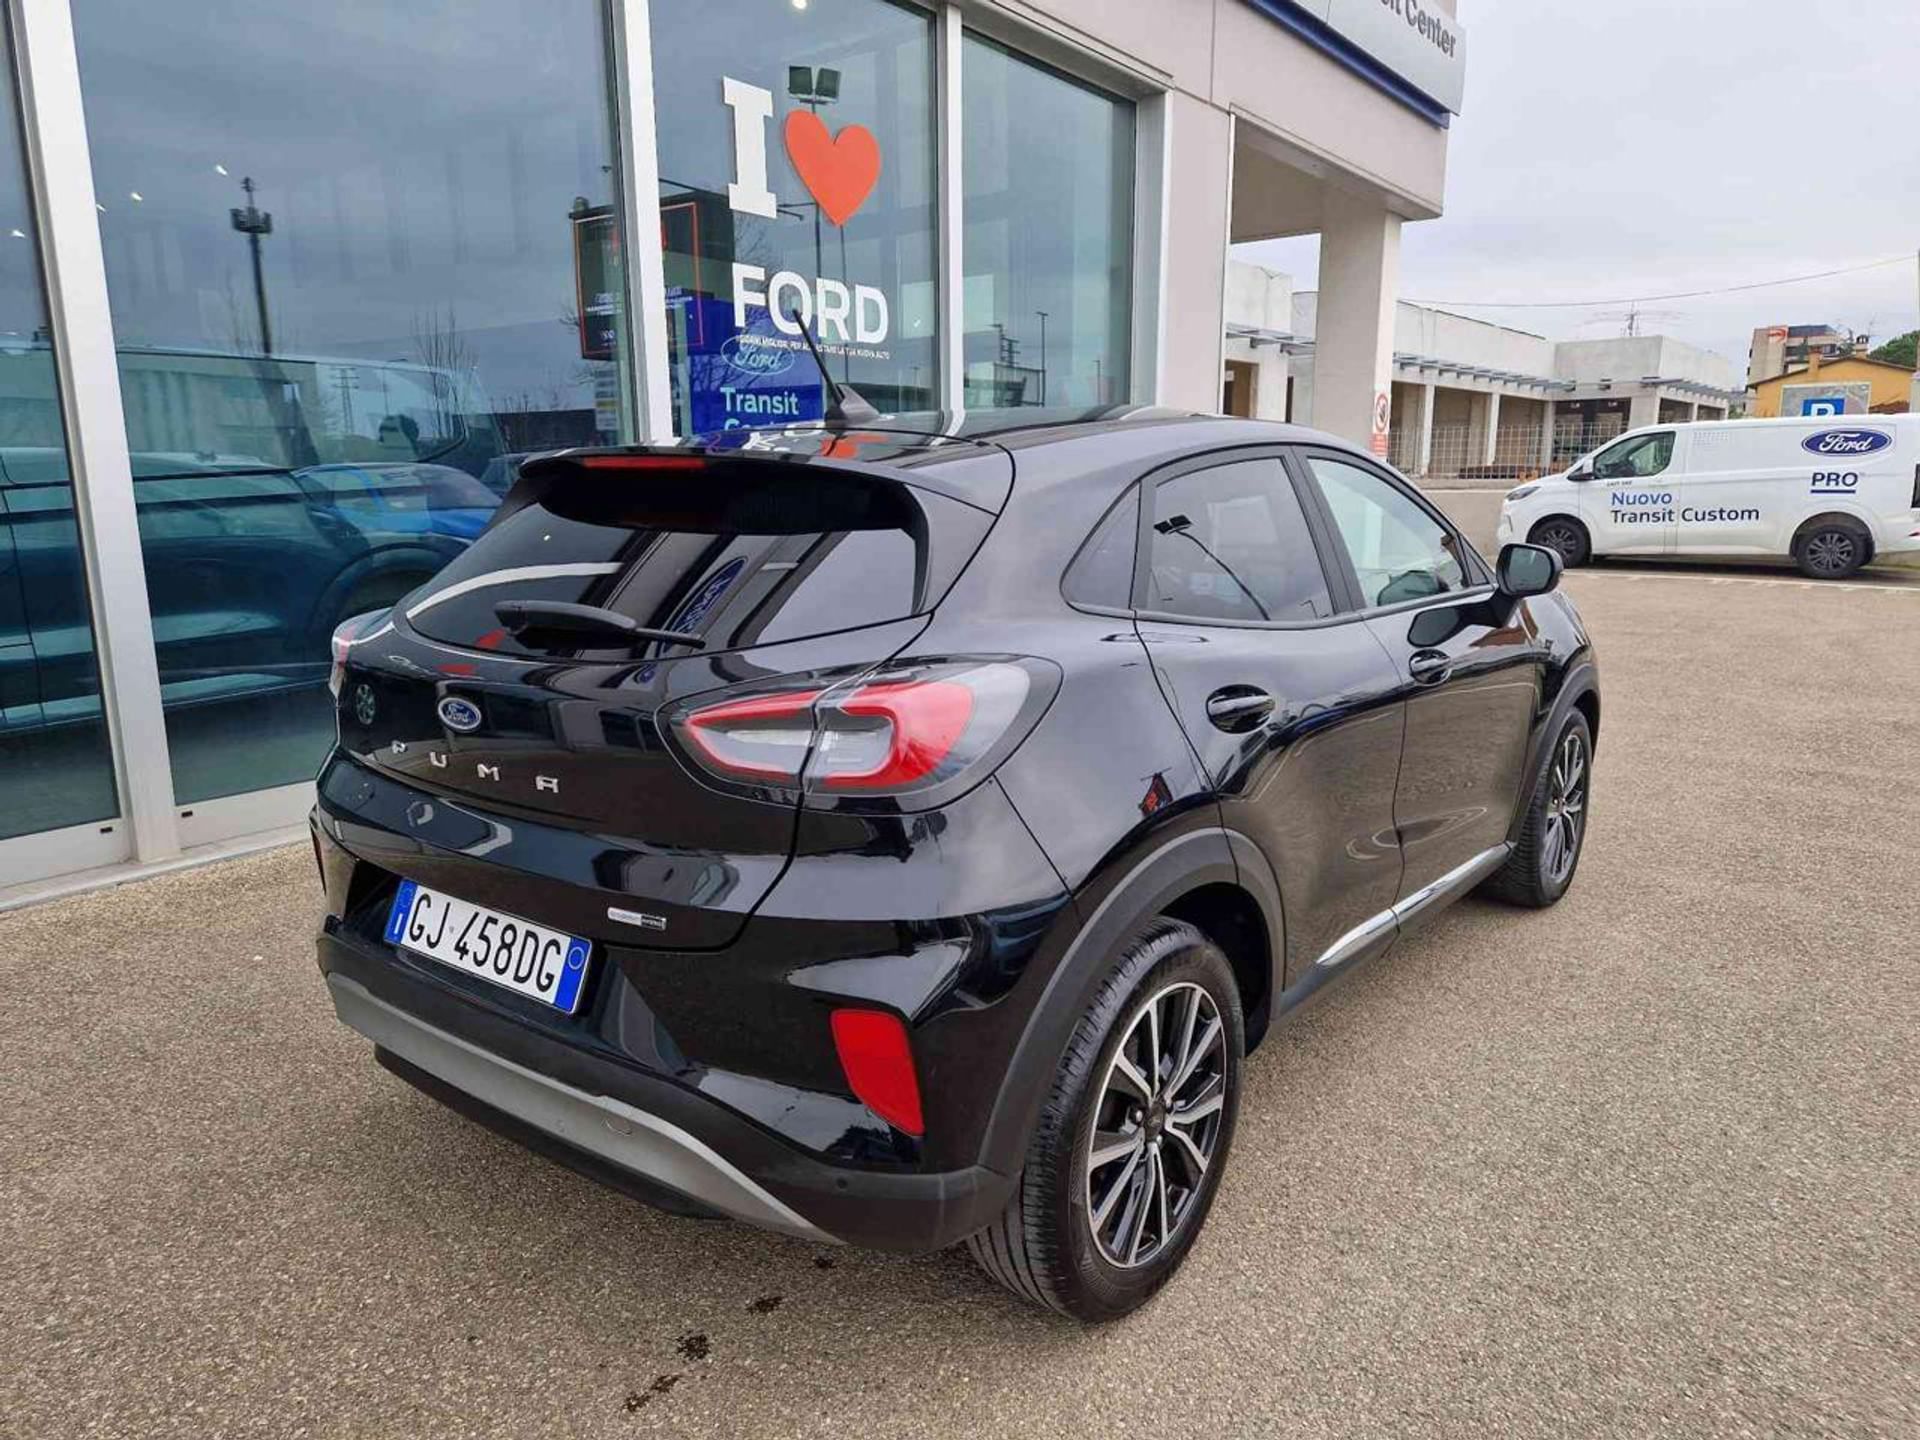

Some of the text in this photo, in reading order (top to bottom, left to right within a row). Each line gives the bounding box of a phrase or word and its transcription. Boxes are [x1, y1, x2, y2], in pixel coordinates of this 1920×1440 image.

[723, 75, 777, 219] I
[732, 262, 889, 344] FORD
[720, 387, 799, 415] Transit
[1819, 433, 1873, 452] Ford
[1812, 472, 1858, 487] PRO
[1611, 492, 1673, 506] Nuovo
[1611, 507, 1760, 524] Transit Custom
[392, 740, 560, 794] PUMA
[408, 893, 562, 993] GJ 458DG
